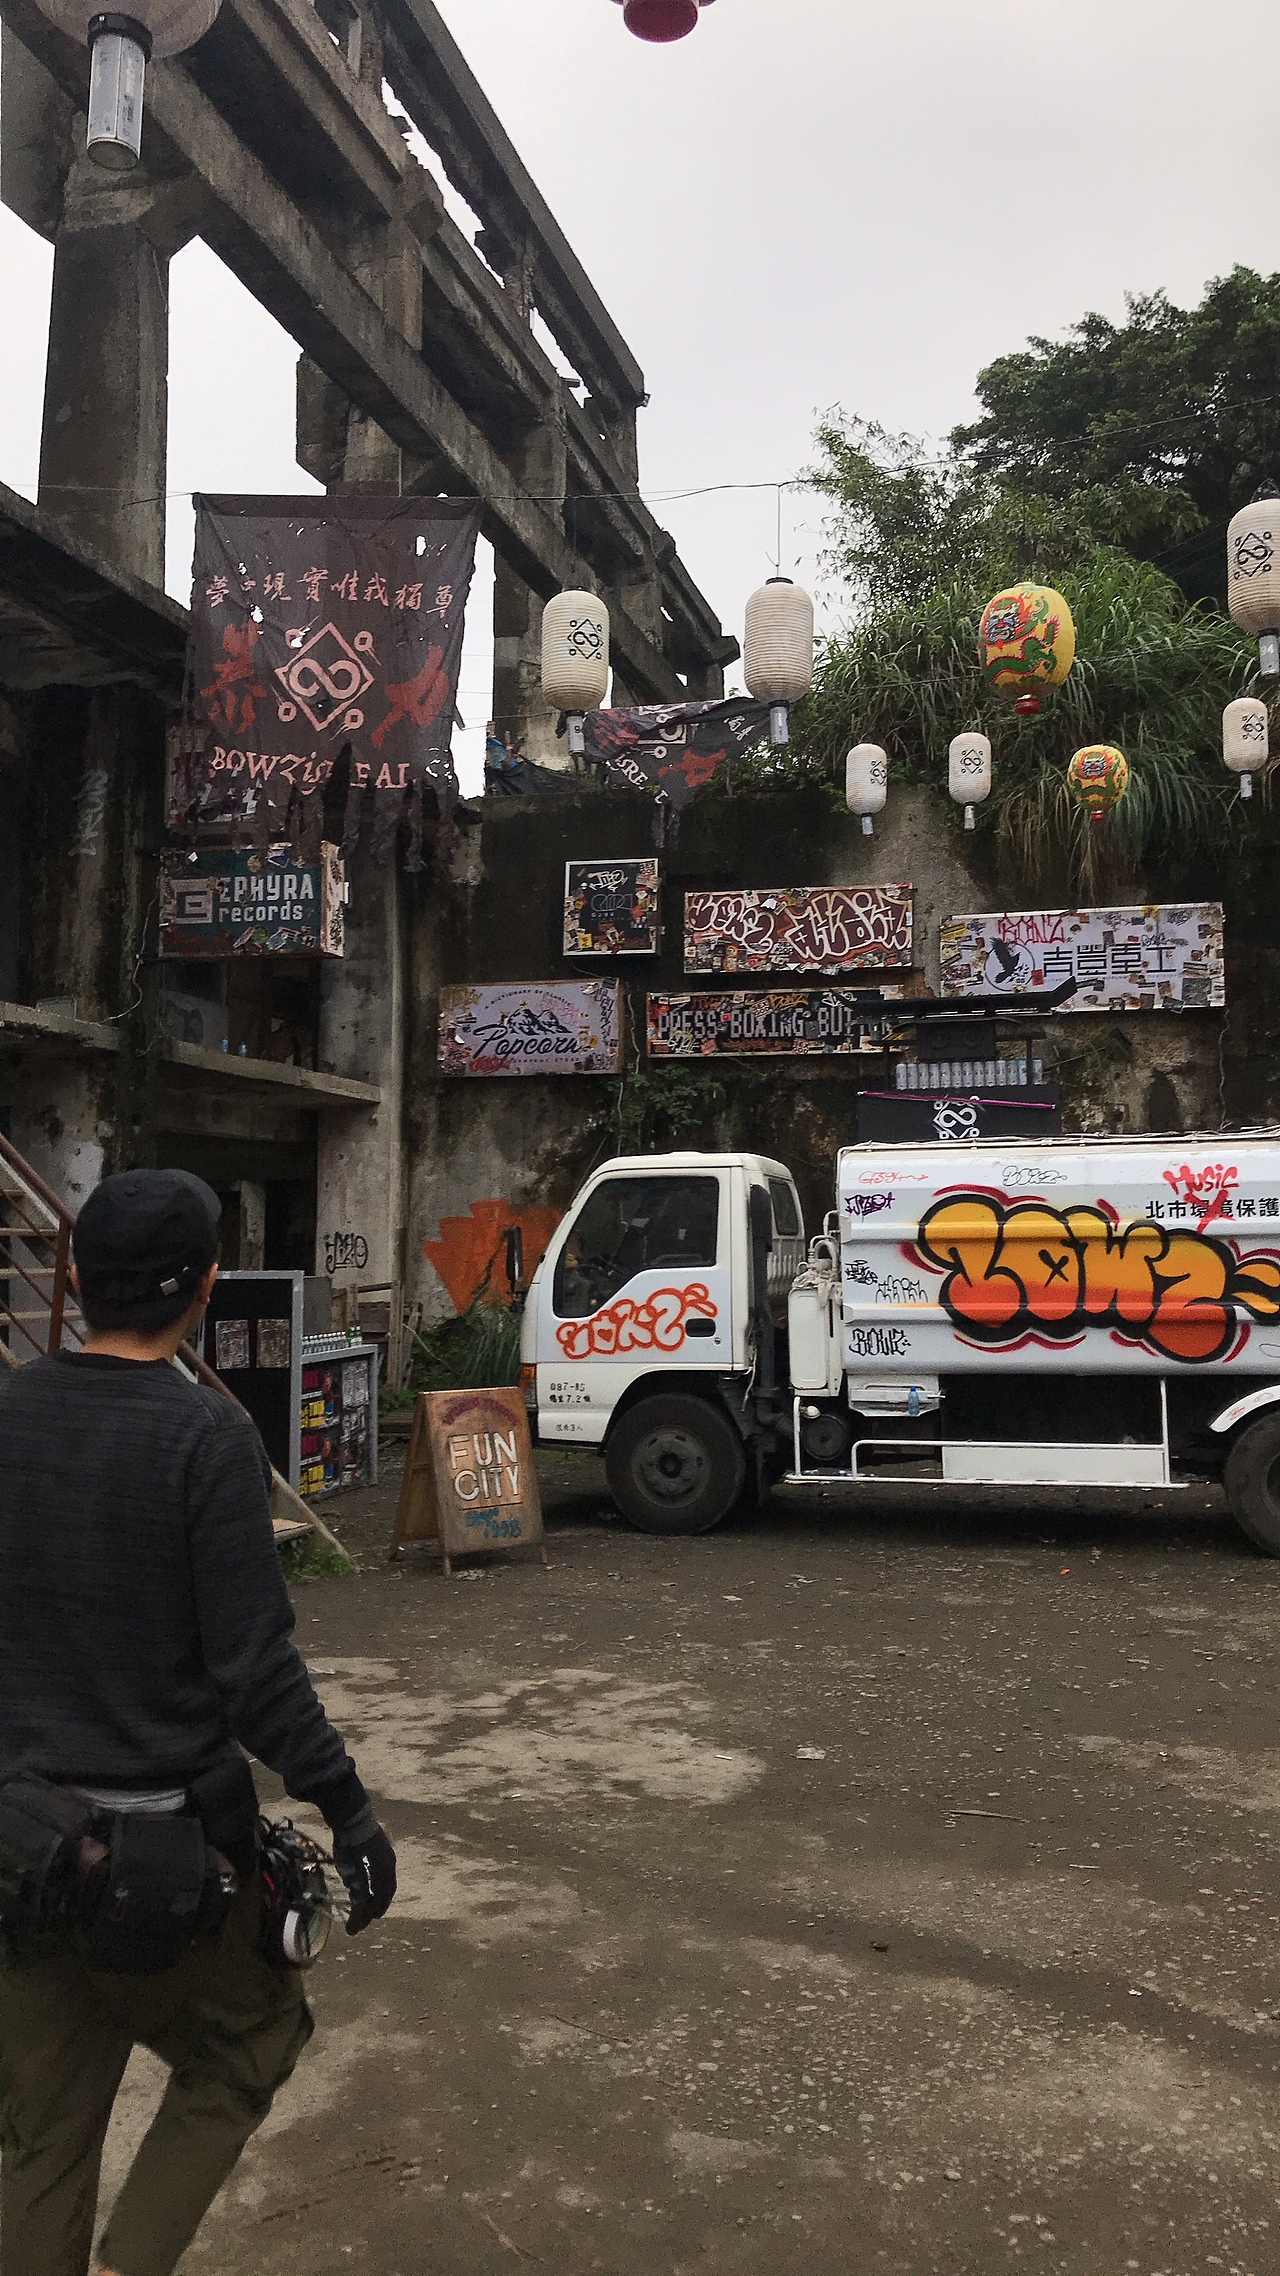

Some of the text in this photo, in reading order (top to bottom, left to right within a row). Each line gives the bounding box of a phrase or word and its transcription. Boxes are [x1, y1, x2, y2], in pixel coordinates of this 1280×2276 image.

[218, 901, 303, 923] records
[473, 1023, 588, 1060] Popcorn
[658, 1009, 718, 1040] PRESS
[731, 1008, 805, 1038] BOXING
[447, 1429, 519, 1470] FUN
[453, 1464, 520, 1502] CITY
